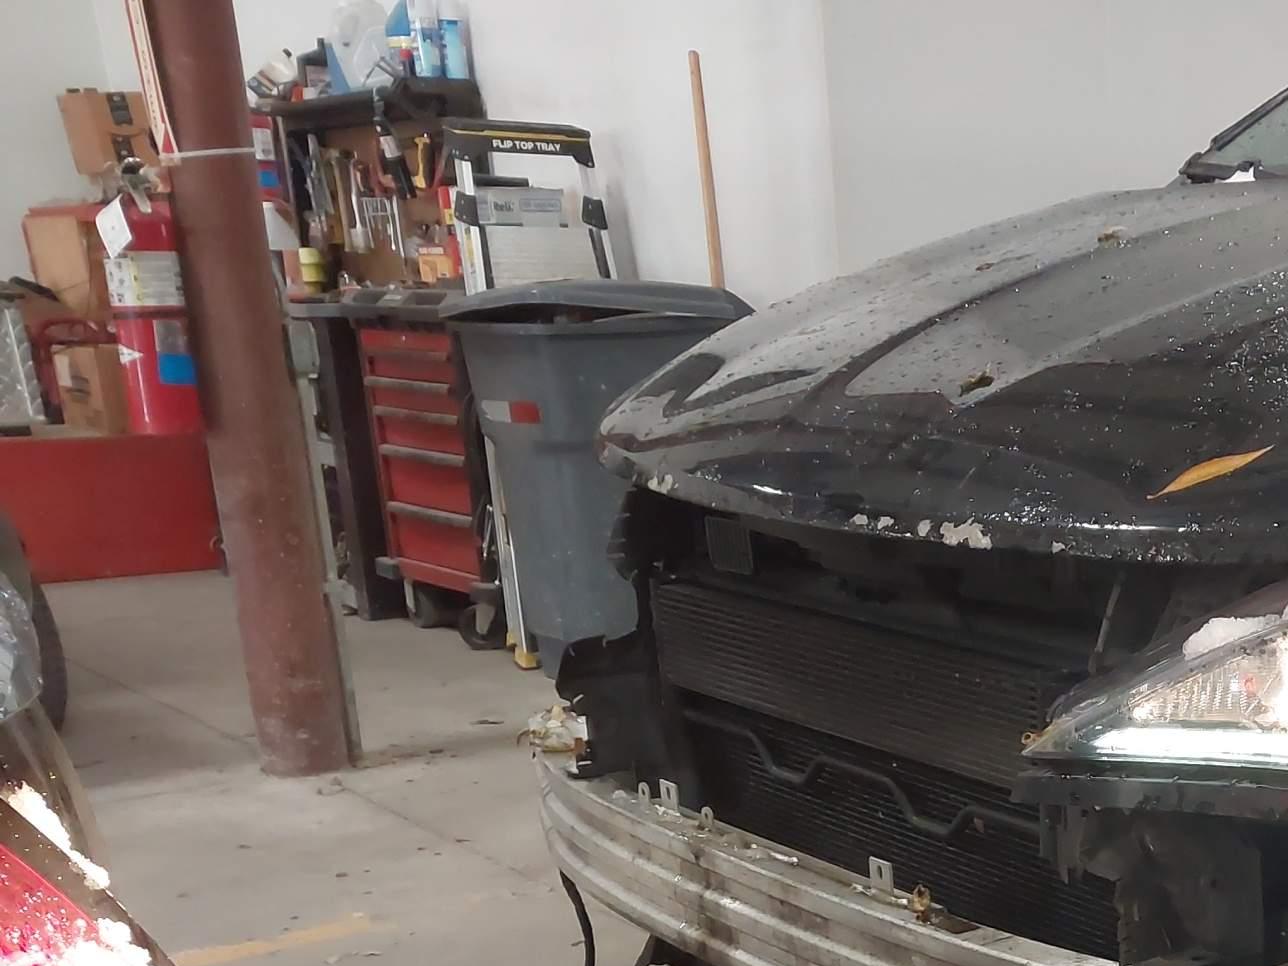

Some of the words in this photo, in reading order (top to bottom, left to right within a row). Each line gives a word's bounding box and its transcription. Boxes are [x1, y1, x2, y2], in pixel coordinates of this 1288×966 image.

[492, 139, 513, 149] FLIP
[514, 140, 534, 151] TOP
[535, 142, 561, 152] TRAY
